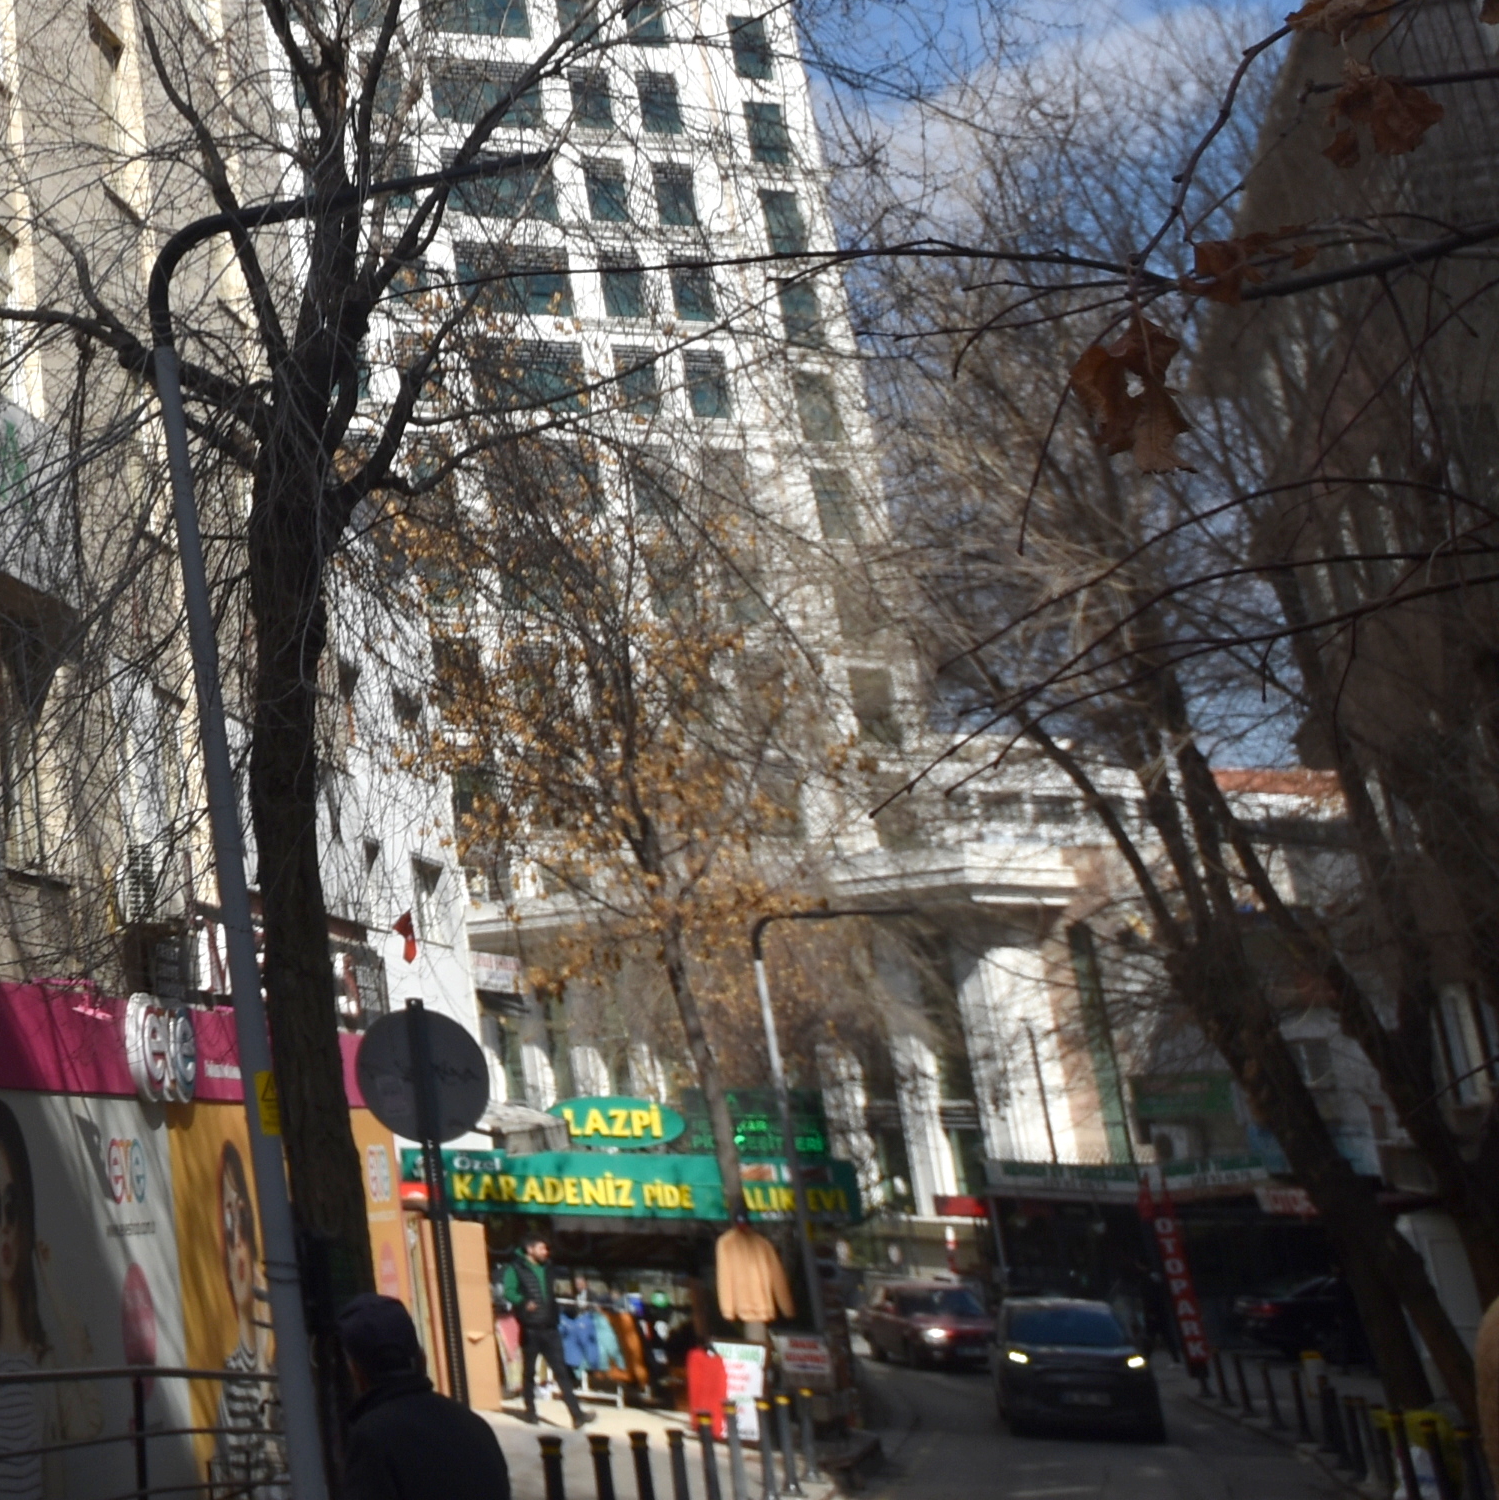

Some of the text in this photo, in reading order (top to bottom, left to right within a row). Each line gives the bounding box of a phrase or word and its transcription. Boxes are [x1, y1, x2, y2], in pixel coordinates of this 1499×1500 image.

[563, 1105, 665, 1139] LAZPİ
[106, 1134, 148, 1208] eve
[452, 1154, 502, 1173] Özel
[451, 1171, 636, 1209] KARADENİZ
[642, 1178, 696, 1209] PİDE
[741, 1186, 796, 1212] ALIK
